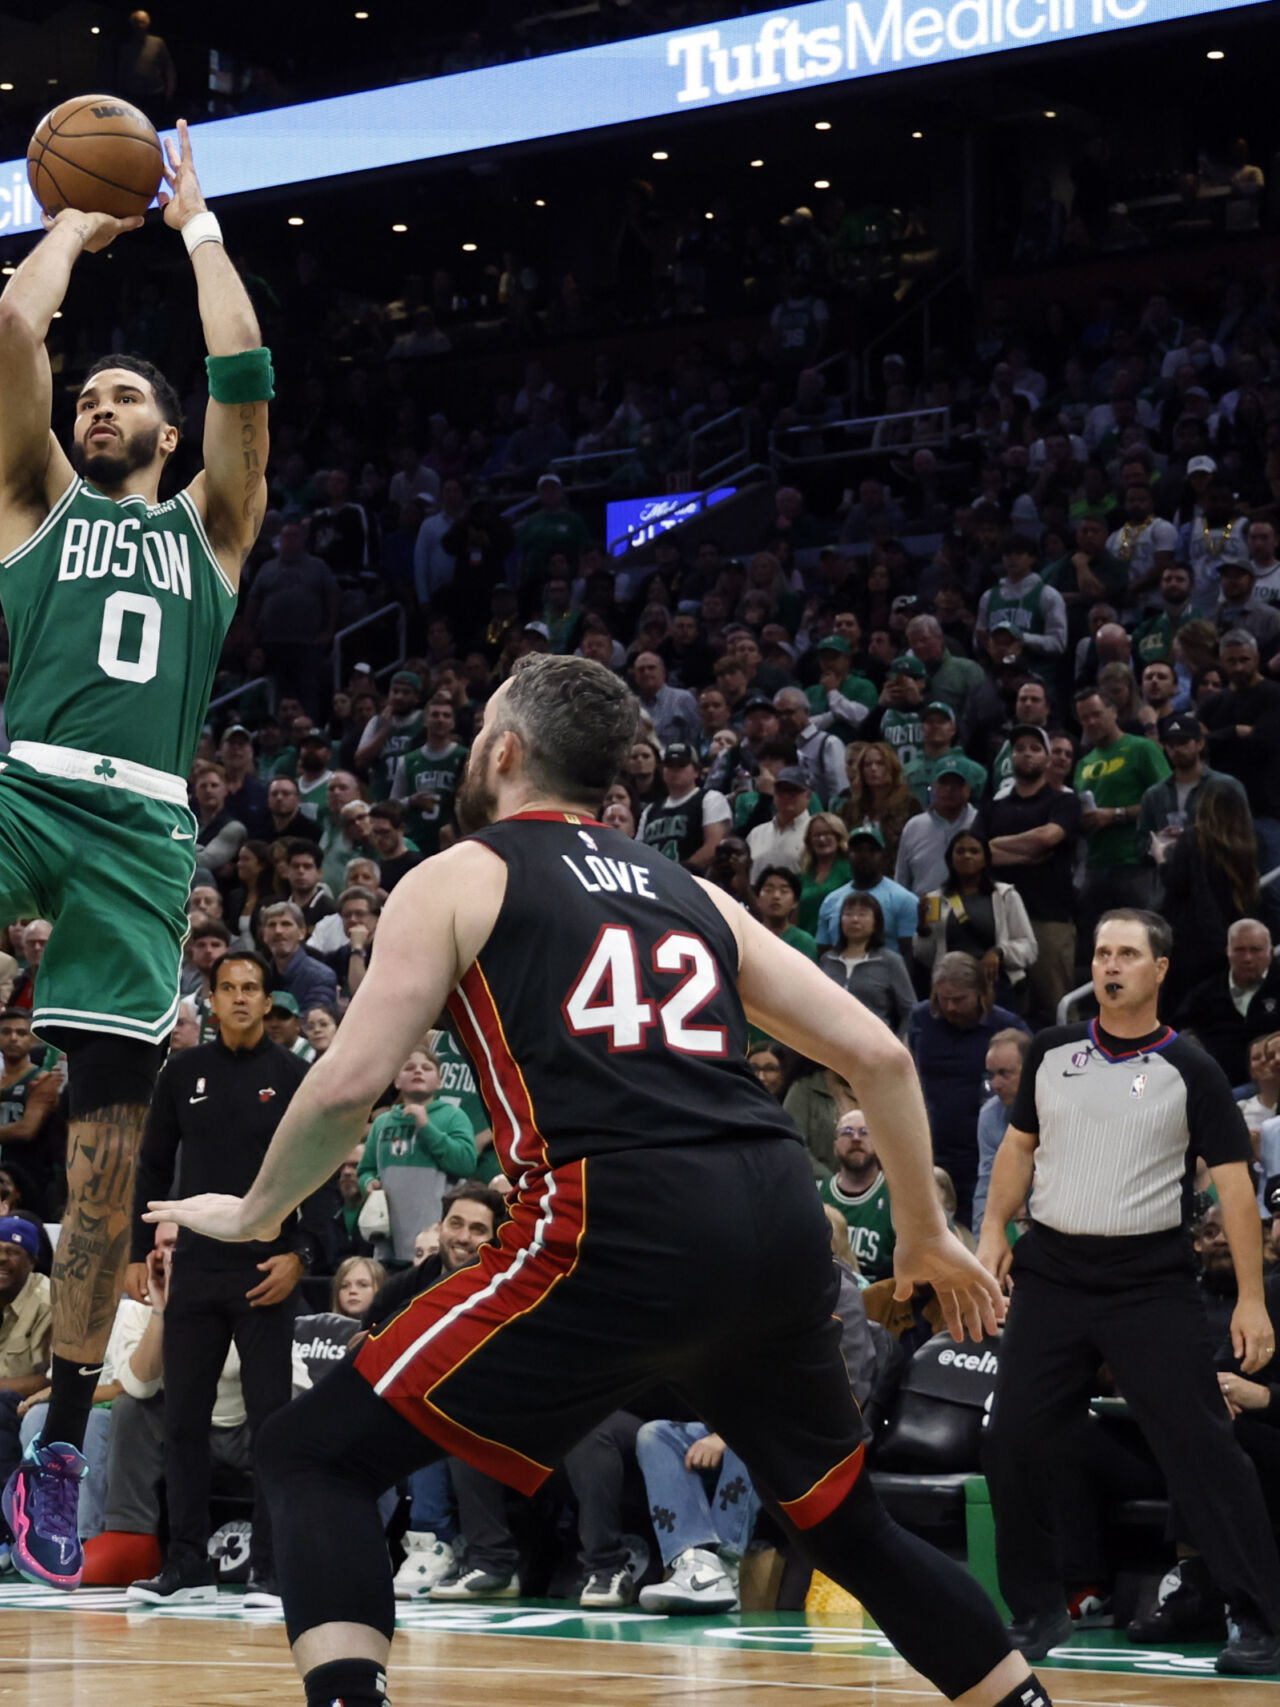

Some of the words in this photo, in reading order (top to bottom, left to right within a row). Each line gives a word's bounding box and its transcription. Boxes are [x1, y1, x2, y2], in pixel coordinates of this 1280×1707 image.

[58, 518, 192, 600] BOSON
[98, 590, 162, 684] 0
[561, 855, 660, 900] LOVE
[561, 923, 729, 1058] 42
[847, 1226, 880, 1262] TICS
